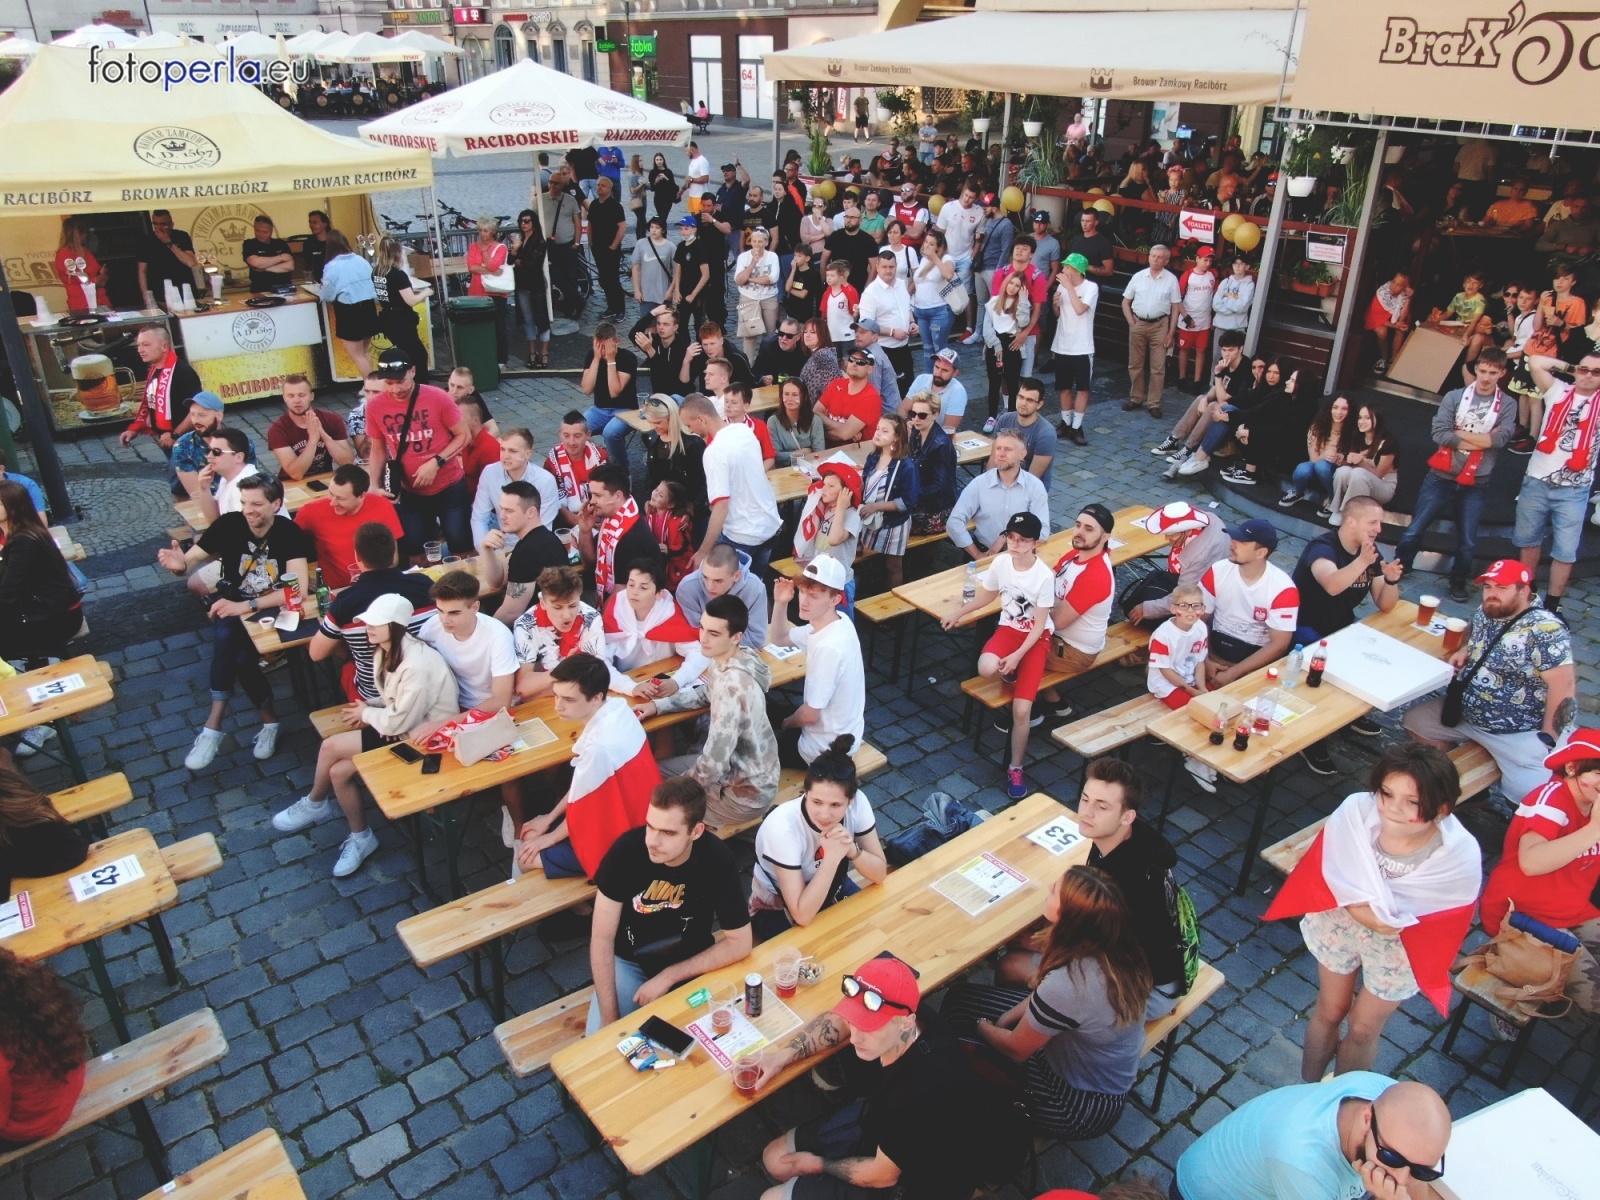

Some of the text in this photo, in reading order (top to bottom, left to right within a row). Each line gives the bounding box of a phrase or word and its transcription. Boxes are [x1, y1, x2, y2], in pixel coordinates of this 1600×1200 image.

[631, 41, 653, 53] żabka
[1133, 76, 1228, 91] Browar Zamkowy Racibórz
[464, 129, 579, 151] RACIBORSKIE
[603, 128, 681, 142] RACIBORSKIE
[183, 147, 213, 159] 1567
[293, 168, 418, 191] BROWAR RACIBÓRZ
[3, 188, 93, 206] RACIBÓRZ
[121, 180, 269, 202] BROWAR RACIBÓRZ
[1187, 220, 1213, 231] TOALETY
[157, 367, 172, 413] POLSKA
[45, 680, 67, 693] 44
[1044, 825, 1079, 846] 53
[91, 864, 121, 886] 43
[642, 879, 686, 905] NIKE
[690, 1024, 731, 1067] STREFA KIBICA 2021
